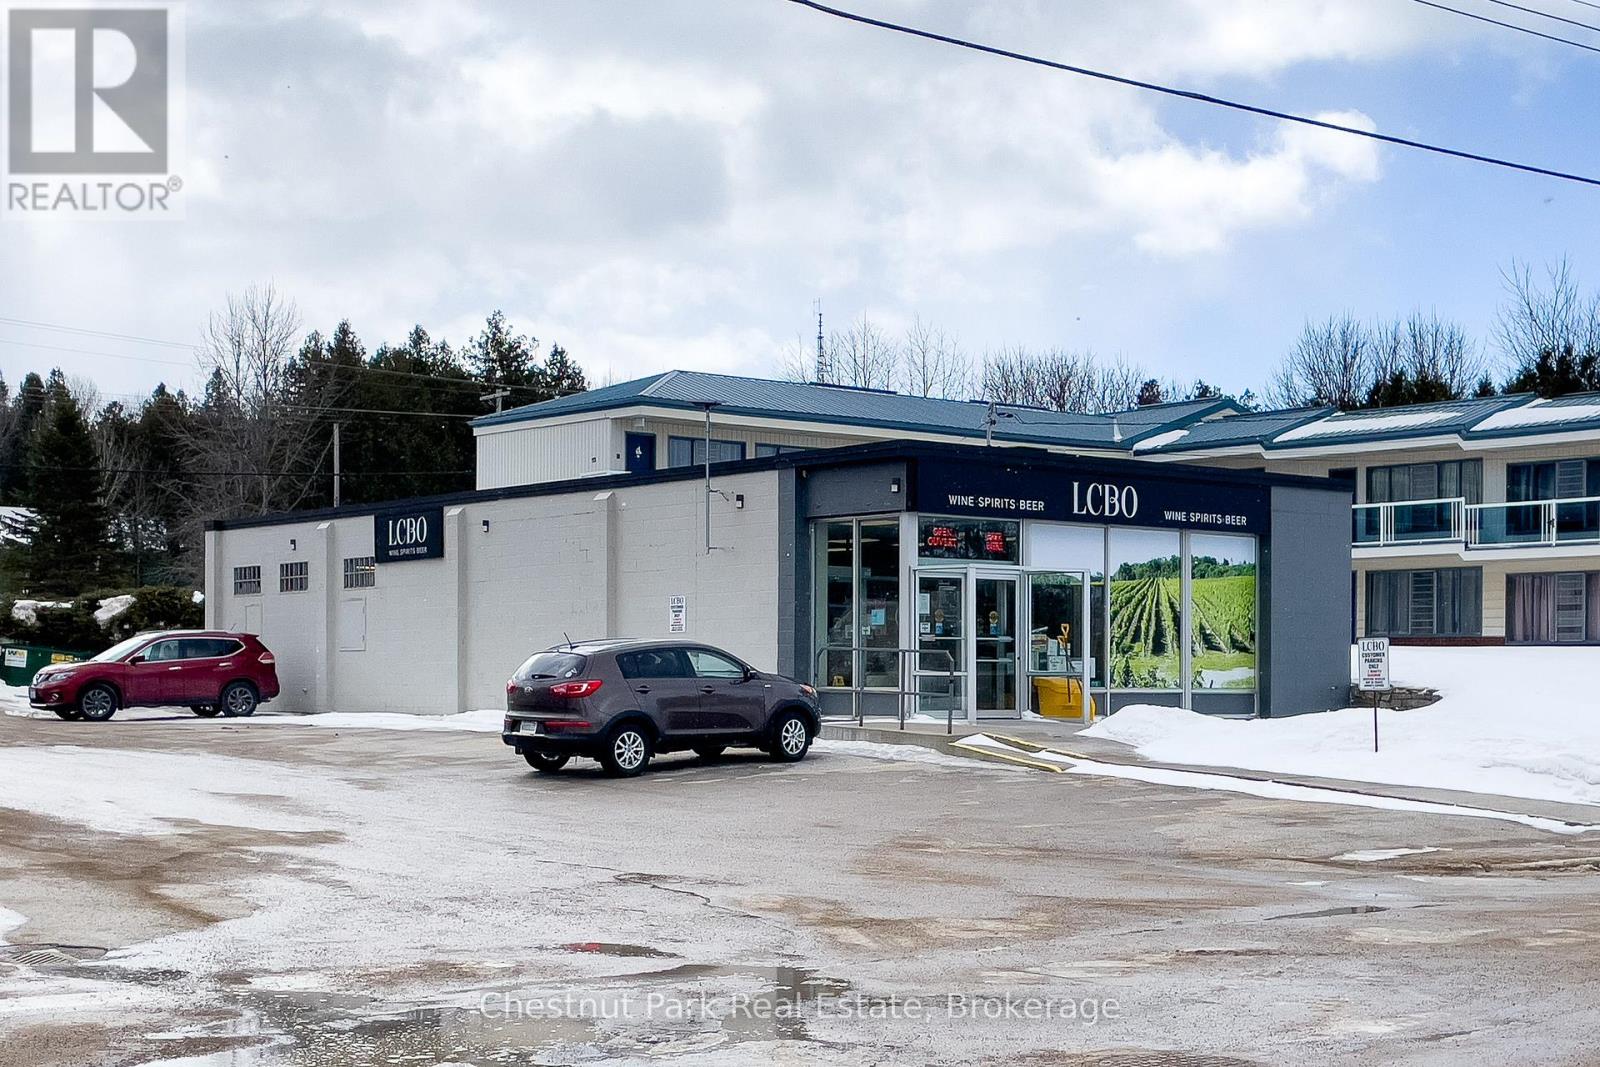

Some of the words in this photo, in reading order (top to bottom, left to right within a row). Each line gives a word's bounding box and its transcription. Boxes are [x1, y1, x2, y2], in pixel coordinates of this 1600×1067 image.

[948, 494, 975, 507] WINE
[978, 496, 1016, 510] SPIRITS
[1019, 499, 1045, 512] BEER
[1072, 481, 1138, 519] LCBO
[1163, 510, 1187, 522] WINE
[1189, 512, 1222, 525] SPIRITS
[1225, 514, 1247, 526] BEER
[388, 516, 428, 546] LCBO
[1362, 641, 1385, 652] LCBO
